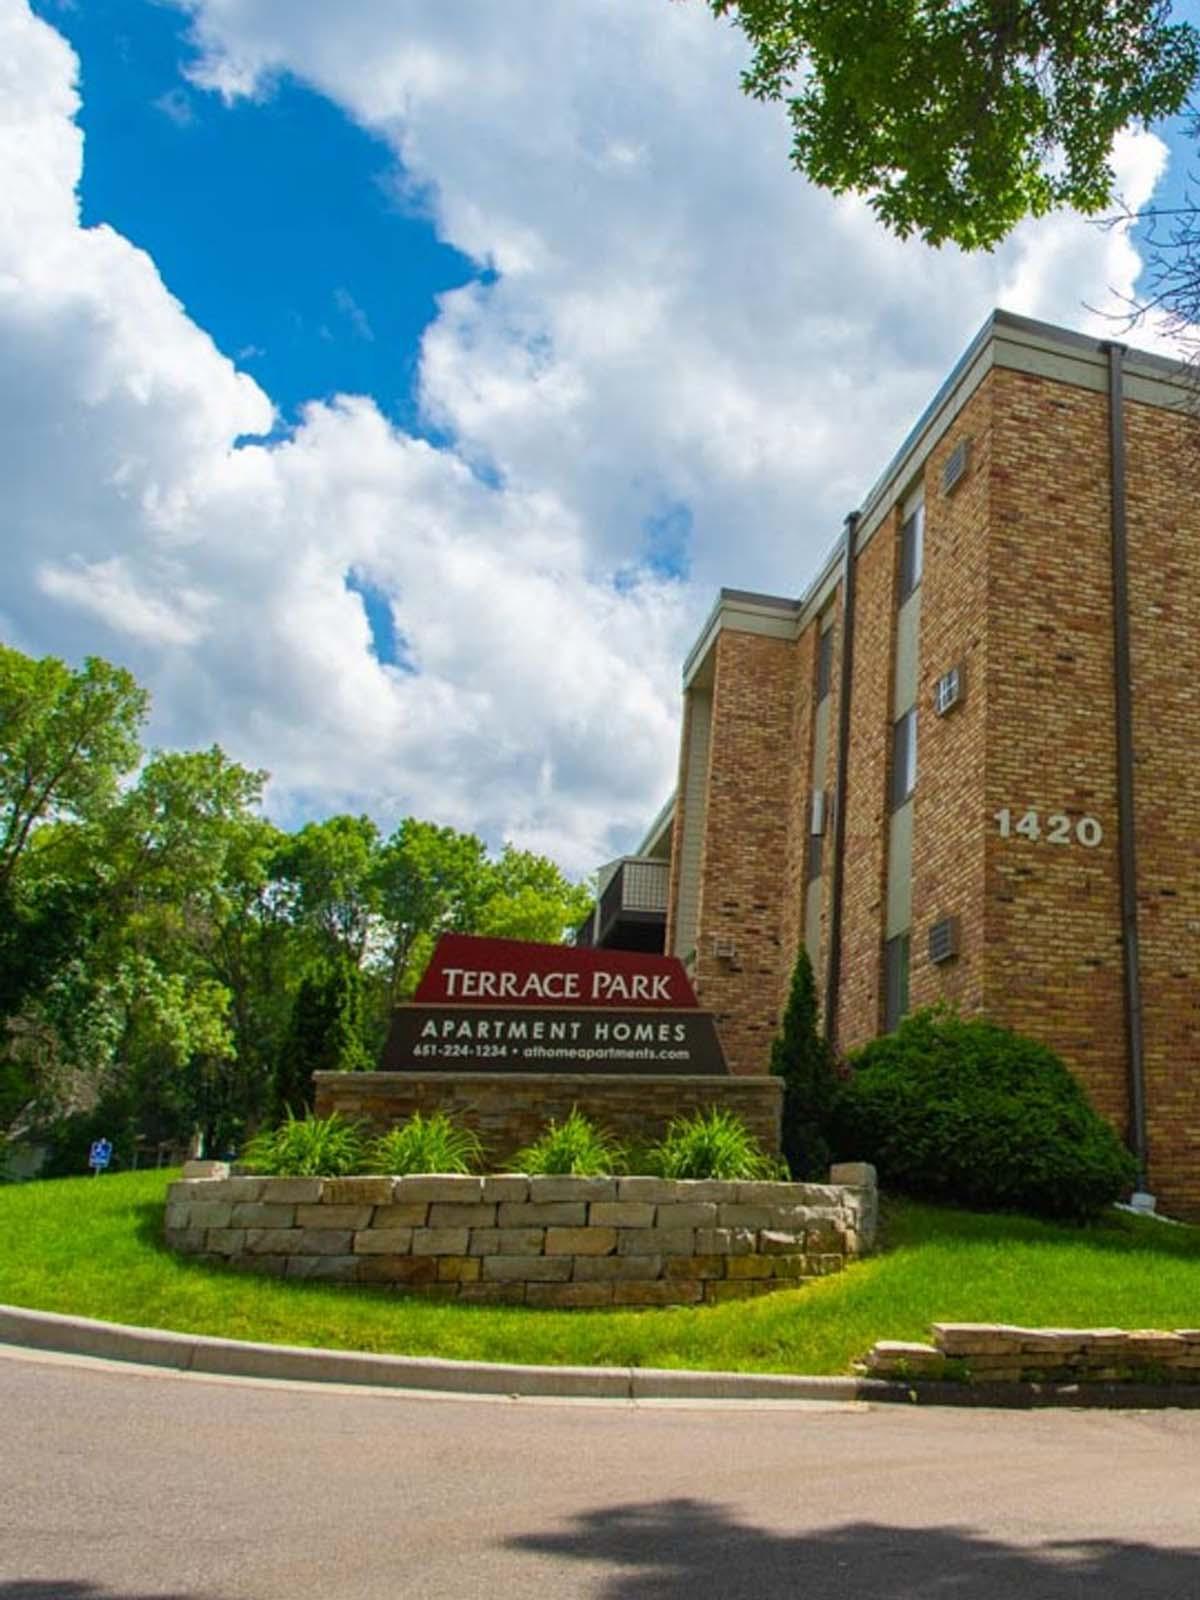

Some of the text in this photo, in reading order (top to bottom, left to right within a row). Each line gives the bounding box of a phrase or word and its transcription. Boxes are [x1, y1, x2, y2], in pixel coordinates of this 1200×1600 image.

[993, 808, 1103, 847] 1420
[442, 969, 672, 1000] TERRACE PARK
[420, 1020, 686, 1042] APARTMENT HOMES
[413, 1043, 690, 1060] 651-224-1234 athomeapartments.com
